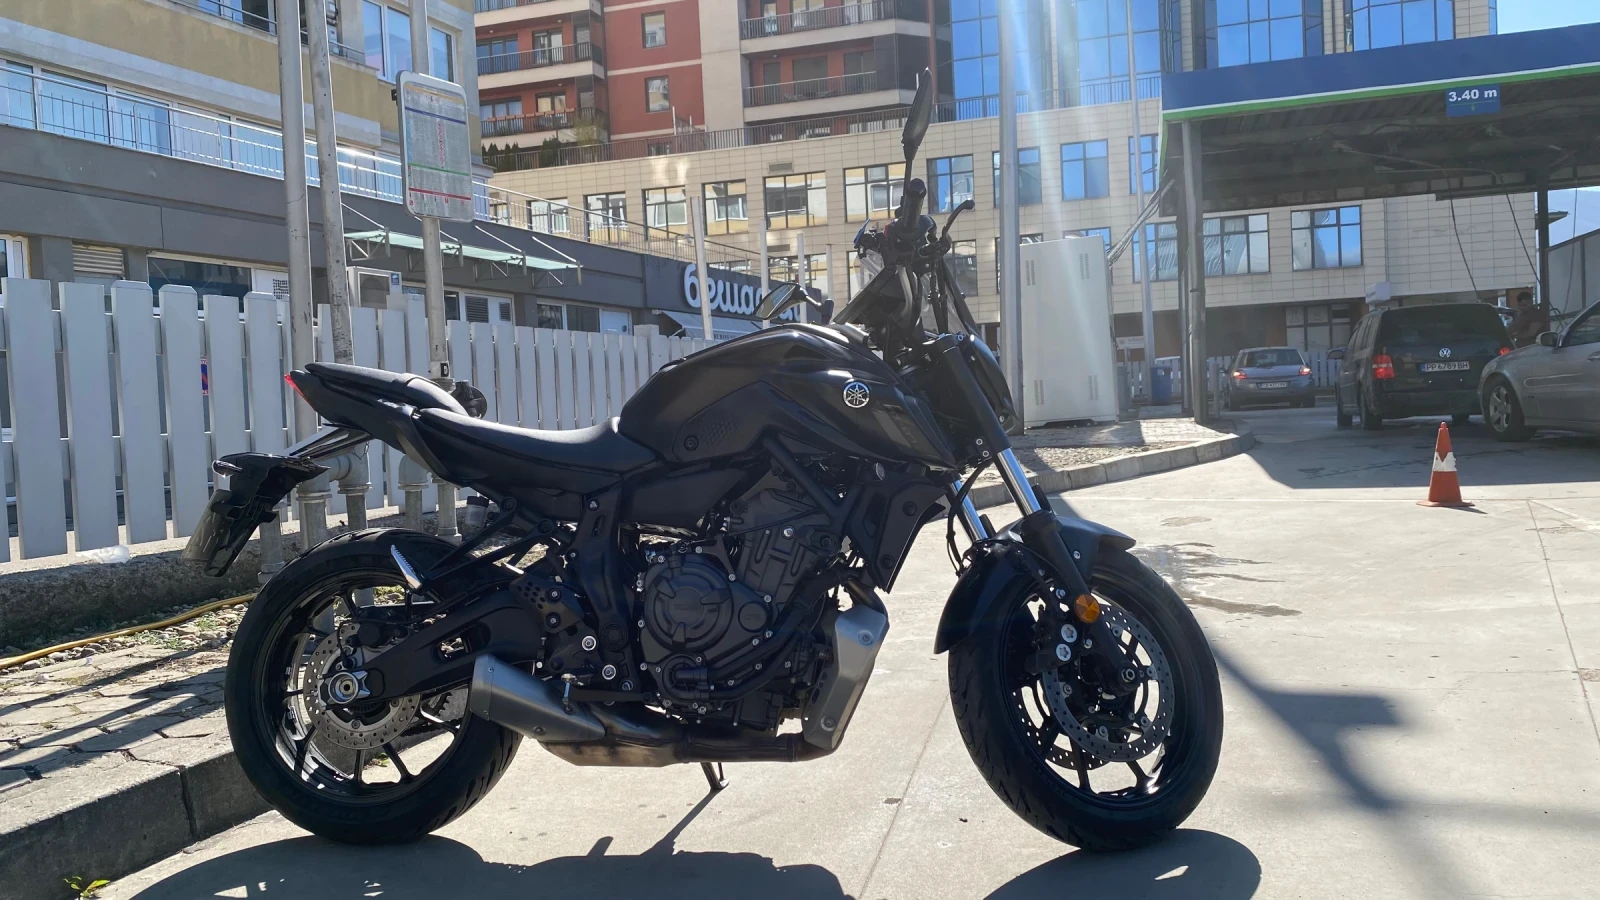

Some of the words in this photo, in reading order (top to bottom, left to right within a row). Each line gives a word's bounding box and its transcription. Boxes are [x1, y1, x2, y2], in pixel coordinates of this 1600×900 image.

[1448, 89, 1479, 102] 3.40
[1484, 89, 1497, 98] m
[684, 263, 803, 322] беша
[1438, 362, 1456, 370] 6789
